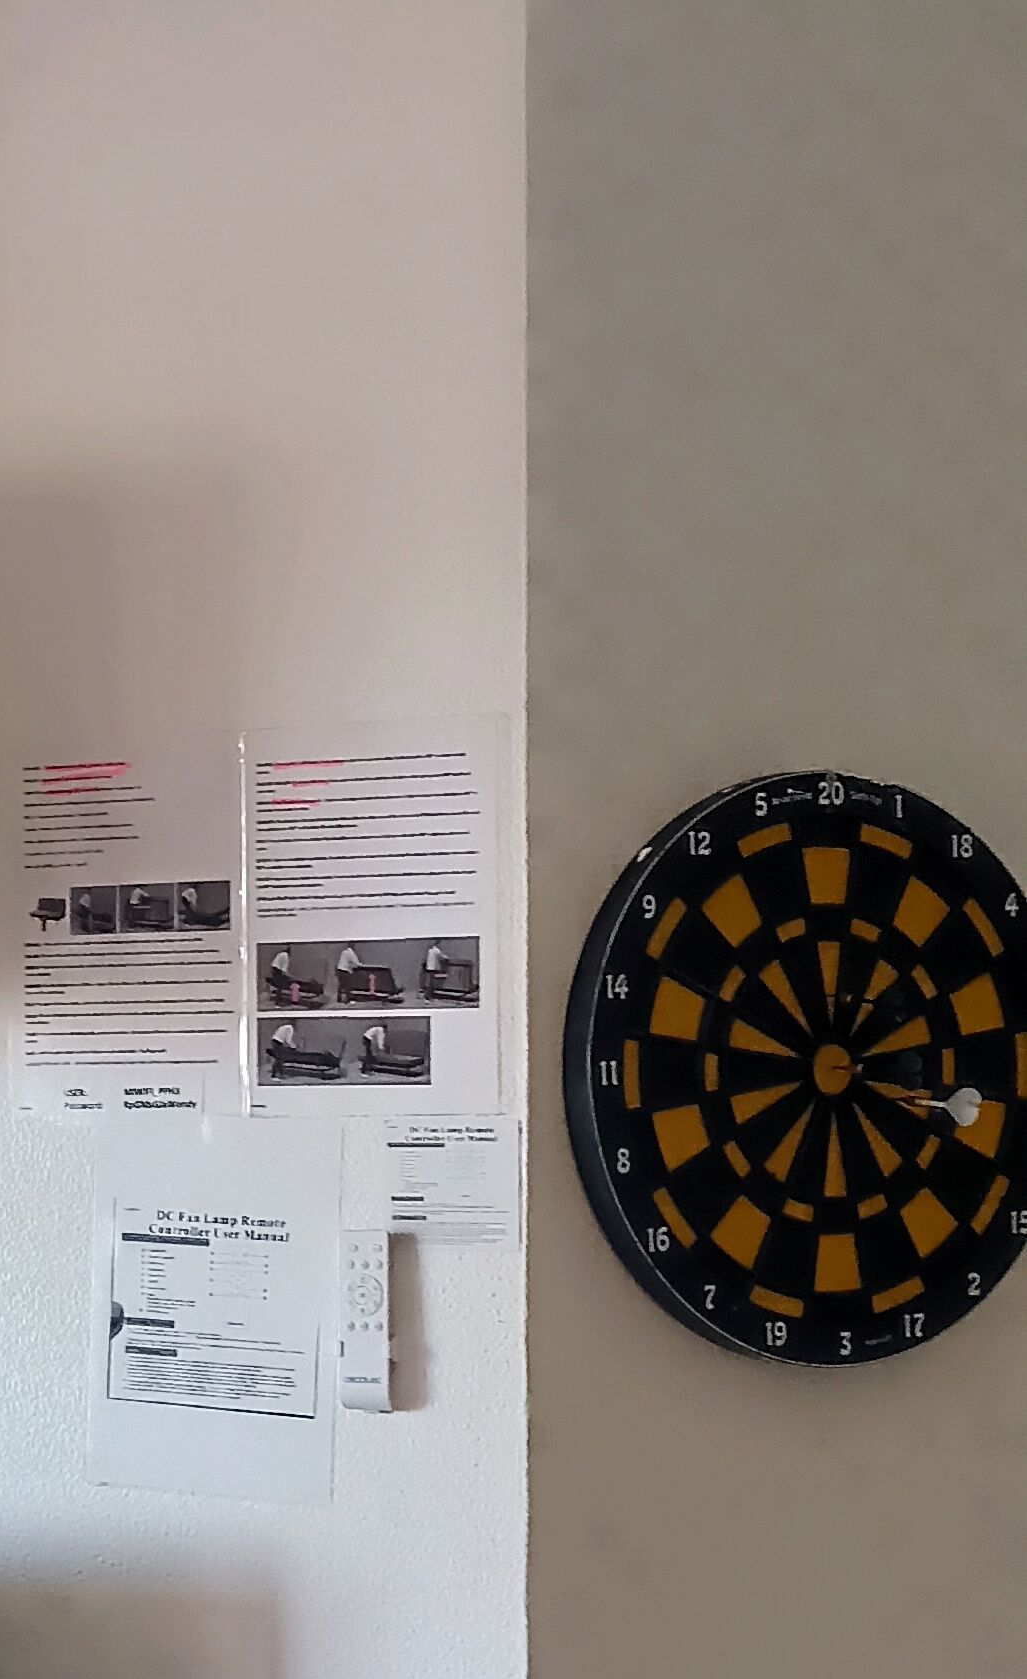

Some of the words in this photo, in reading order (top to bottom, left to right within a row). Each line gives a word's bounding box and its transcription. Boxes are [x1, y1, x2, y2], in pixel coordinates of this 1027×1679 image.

[756, 793, 767, 816] 5
[818, 782, 845, 805] 20
[895, 795, 902, 817] 1
[687, 831, 712, 855] 12
[951, 834, 973, 858] 18
[643, 895, 655, 918] 9
[1005, 893, 1019, 916] 4
[606, 974, 628, 999] 14
[600, 1061, 618, 1085] 11
[617, 1148, 630, 1173] 8
[646, 1227, 670, 1252] 16
[967, 1272, 981, 1296] 2
[703, 1285, 716, 1309] 7
[766, 1322, 787, 1346] 19
[905, 1313, 924, 1337] 17
[840, 1332, 851, 1355] 3
